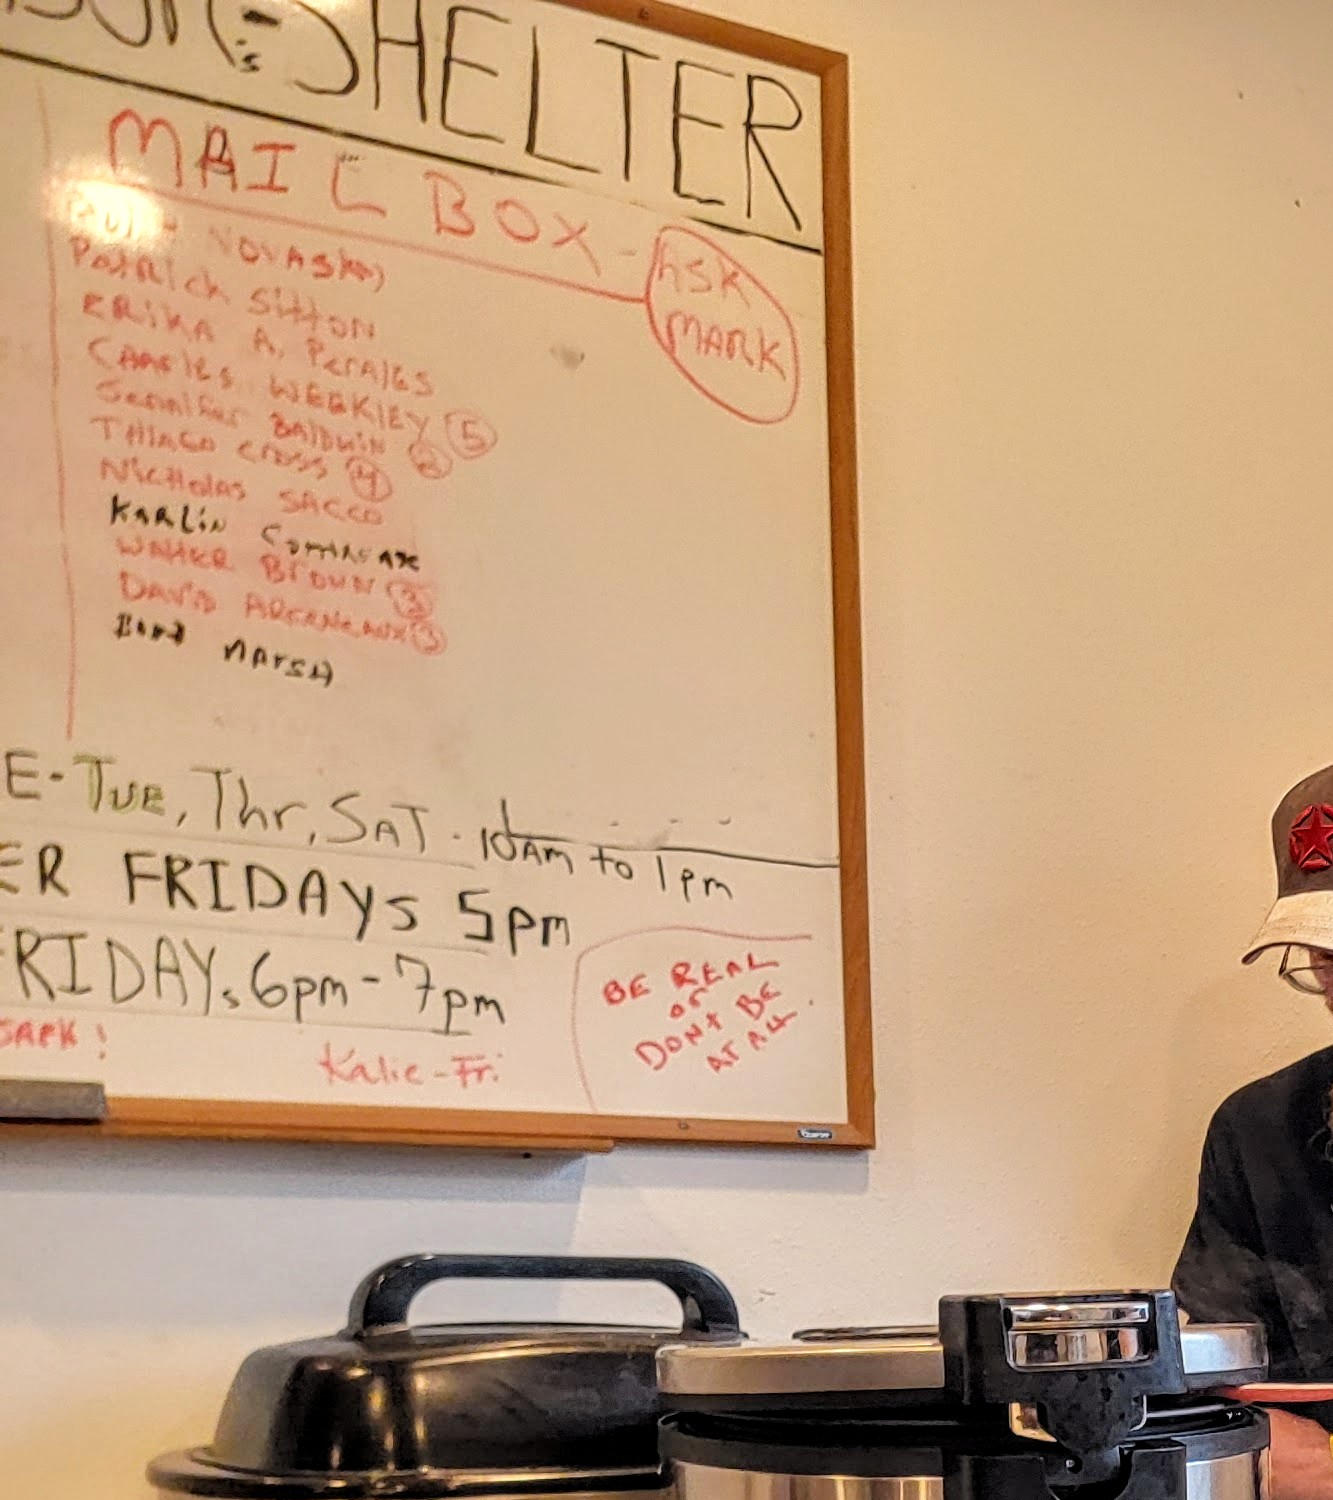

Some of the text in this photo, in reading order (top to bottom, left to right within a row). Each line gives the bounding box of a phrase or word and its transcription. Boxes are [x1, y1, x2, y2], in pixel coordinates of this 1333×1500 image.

[425, 170, 603, 278] BOX
[666, 310, 787, 382] MARK
[457, 889, 571, 957] 5pm
[603, 951, 781, 1006] BE REAL
[735, 980, 783, 1022] BE
